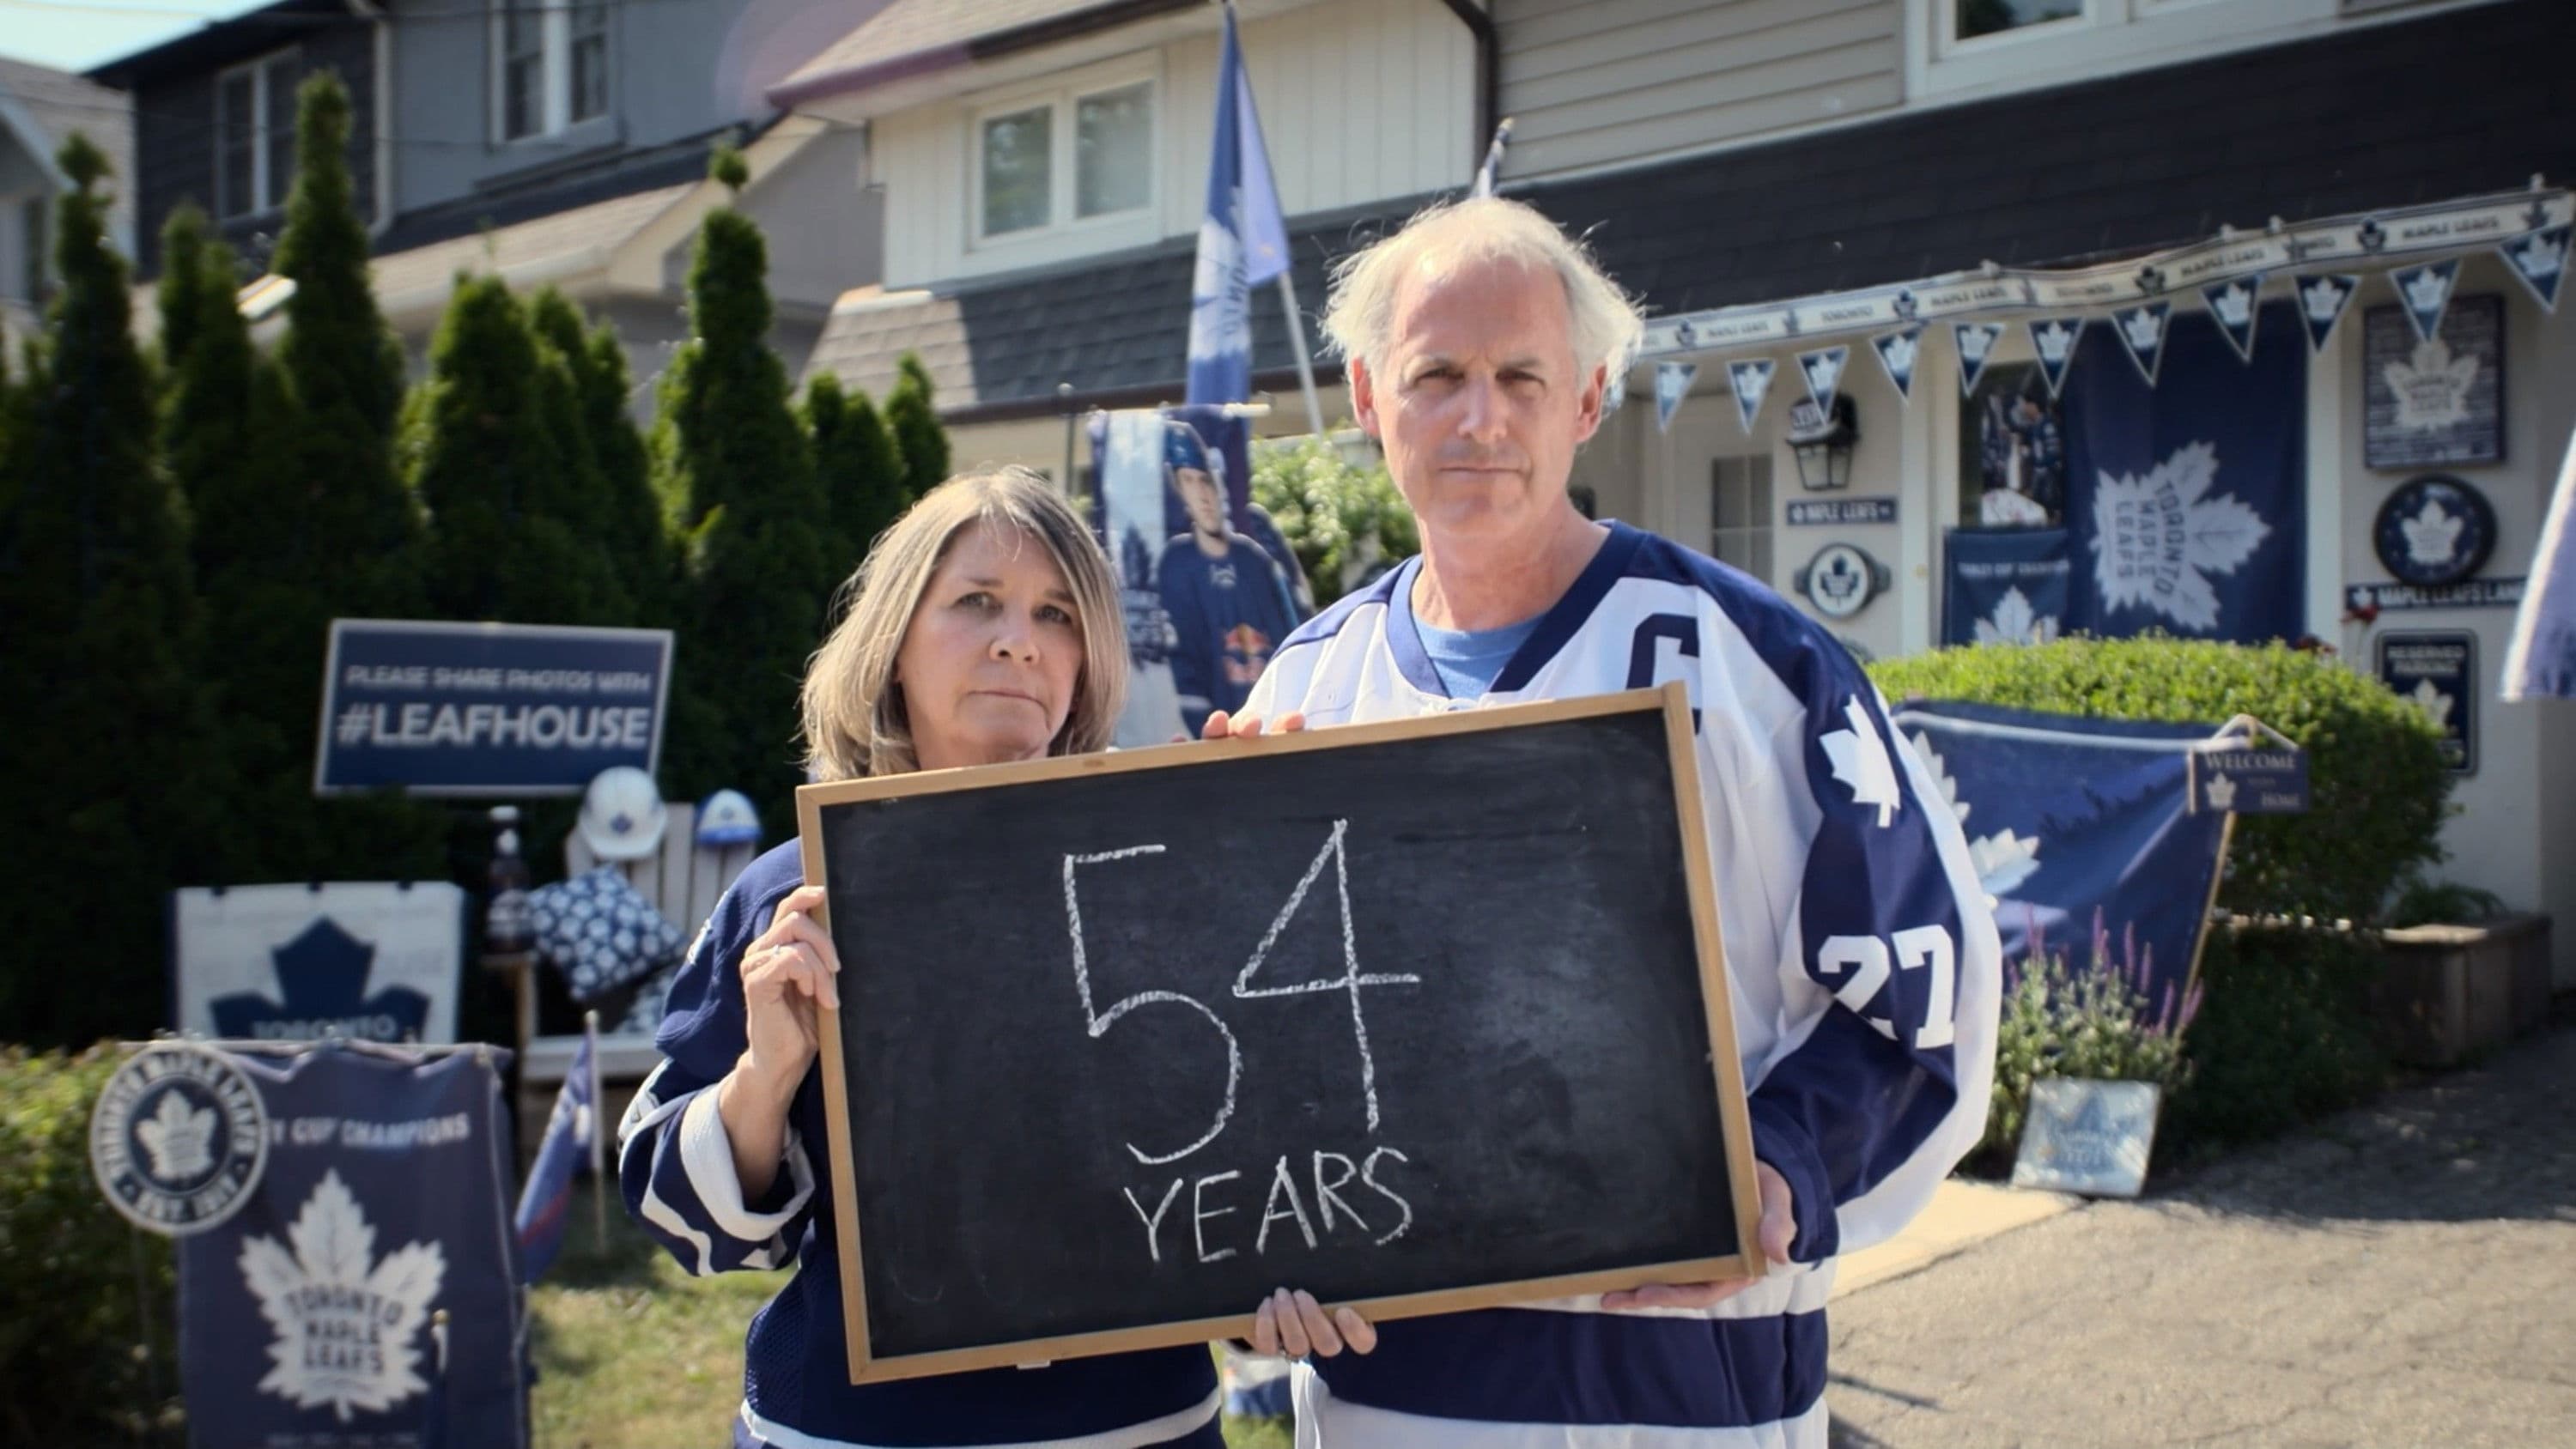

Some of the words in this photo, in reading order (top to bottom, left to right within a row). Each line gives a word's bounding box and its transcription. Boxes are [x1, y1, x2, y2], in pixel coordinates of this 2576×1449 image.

[2116, 500, 2135, 578] LEAFS
[345, 664, 428, 688] PLEASE
[433, 666, 504, 690] SHARE
[506, 668, 594, 692] PHOTOS
[598, 670, 652, 694] WITH
[337, 702, 652, 749] #LEAFHOUSE
[2204, 753, 2295, 770] WELCOME
[1063, 818, 1421, 1165] 54
[1818, 925, 1956, 1050] 27
[1123, 1146, 1413, 1264] YEARS
[283, 1283, 404, 1326] TORONTO
[304, 1344, 385, 1376] LEAFS
